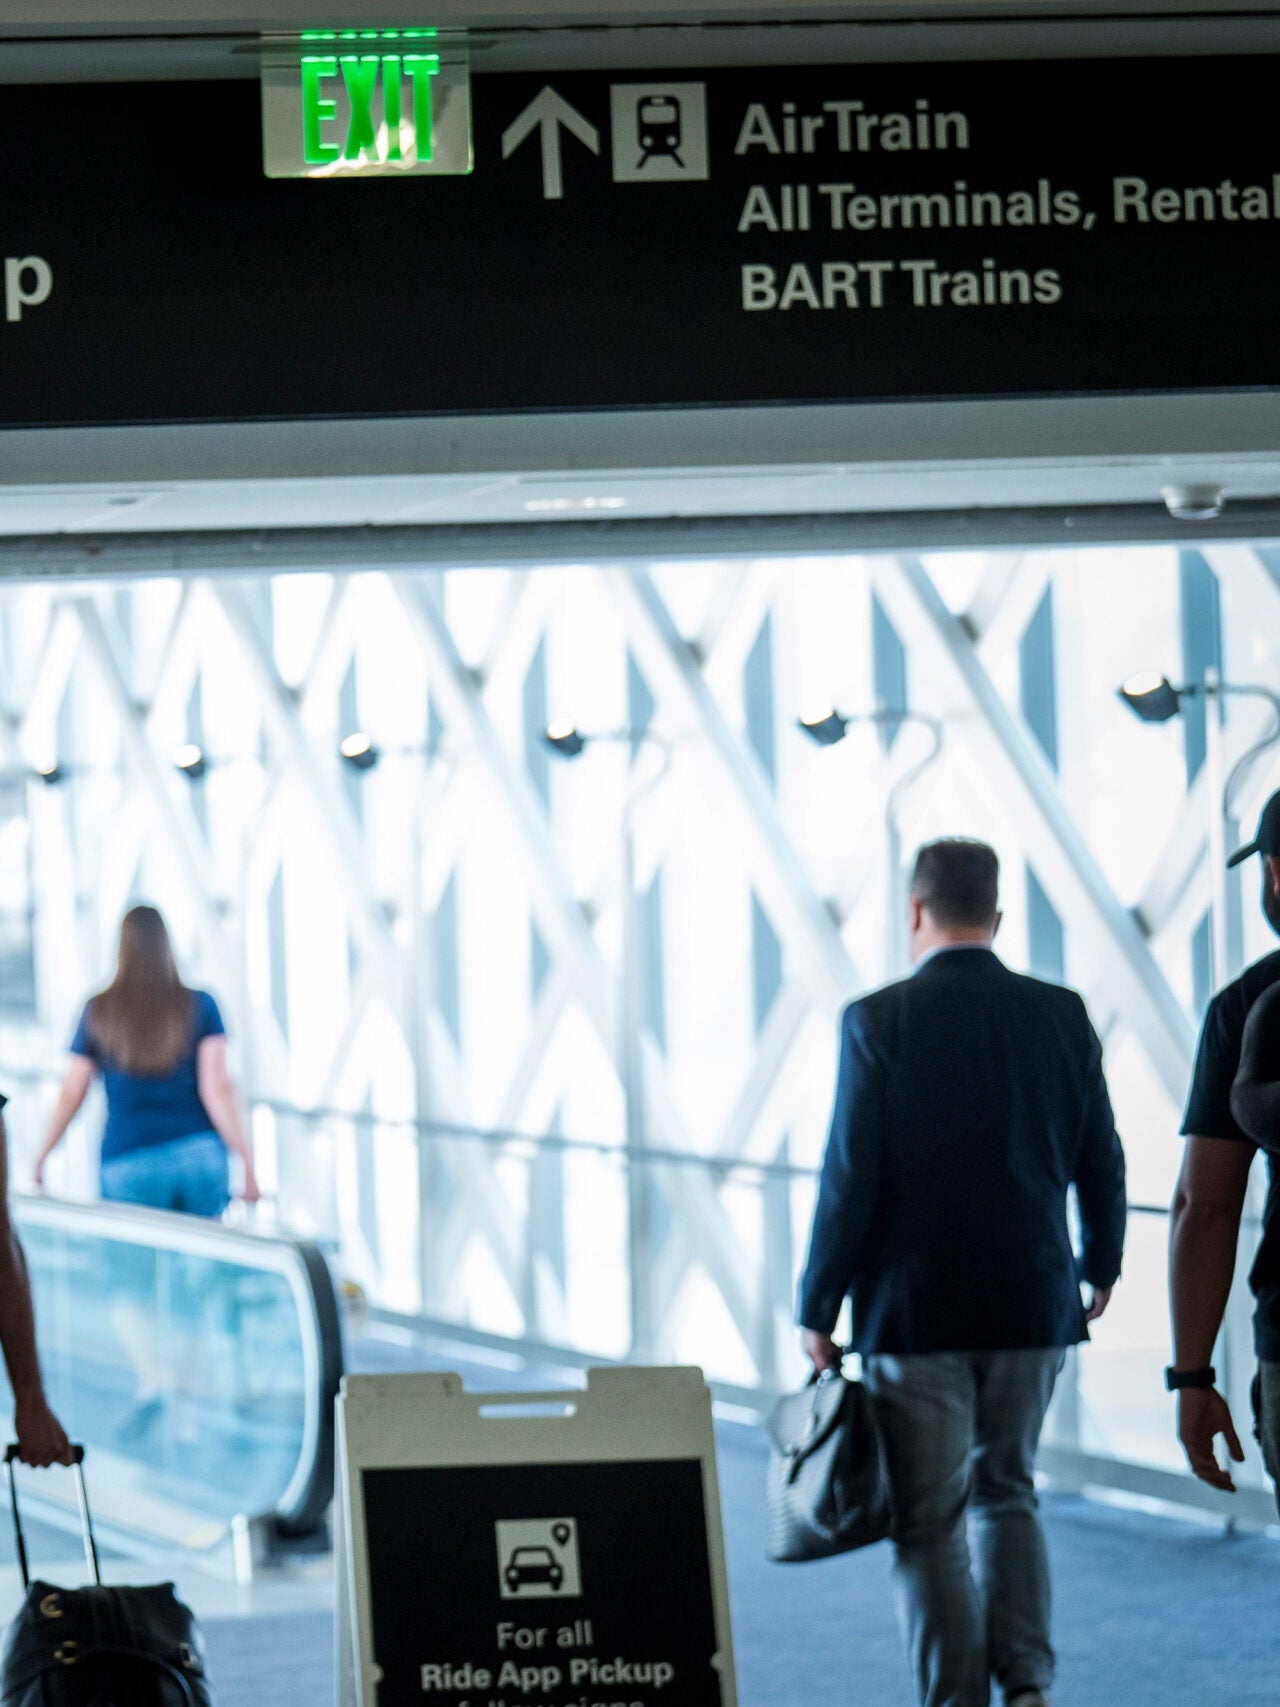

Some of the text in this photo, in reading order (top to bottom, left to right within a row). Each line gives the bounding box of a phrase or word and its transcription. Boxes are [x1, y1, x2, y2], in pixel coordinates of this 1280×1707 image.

[300, 54, 440, 164] EXIT
[735, 100, 968, 155] AirTrain
[737, 174, 1280, 232] All Terminals, Rental
[741, 259, 1062, 311] BART Trains
[496, 1620, 593, 1649] For all
[421, 1657, 674, 1692] Ride App Pickup
